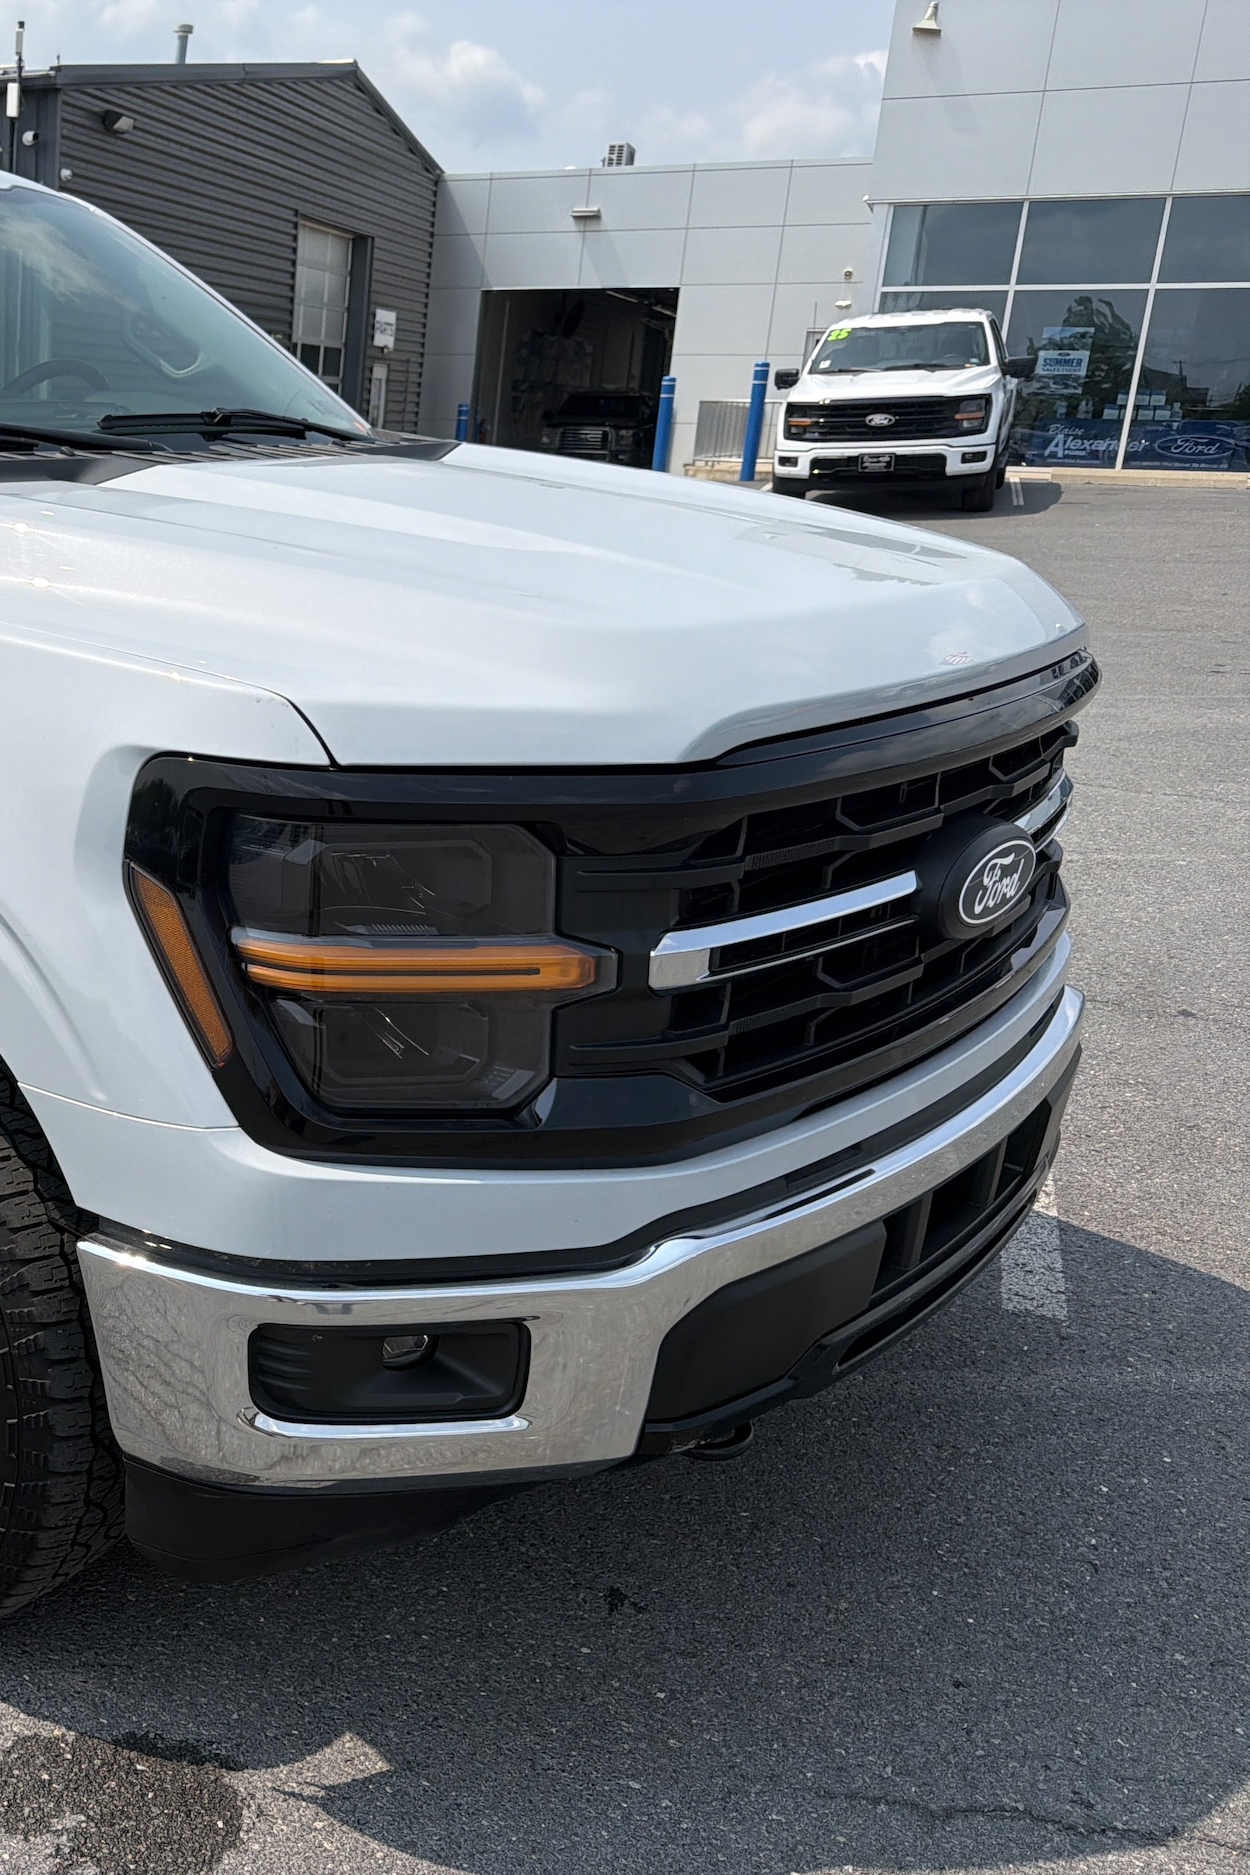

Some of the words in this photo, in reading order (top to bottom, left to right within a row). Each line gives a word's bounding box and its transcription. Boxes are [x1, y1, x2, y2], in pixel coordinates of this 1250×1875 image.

[374, 320, 394, 337] PARTS
[827, 328, 852, 341] 25
[1042, 357, 1083, 368] SUMMER
[1049, 423, 1085, 436] Blaise
[1044, 434, 1150, 458] Alexaner
[1171, 438, 1221, 454] Ford
[974, 852, 1025, 915] Ford
